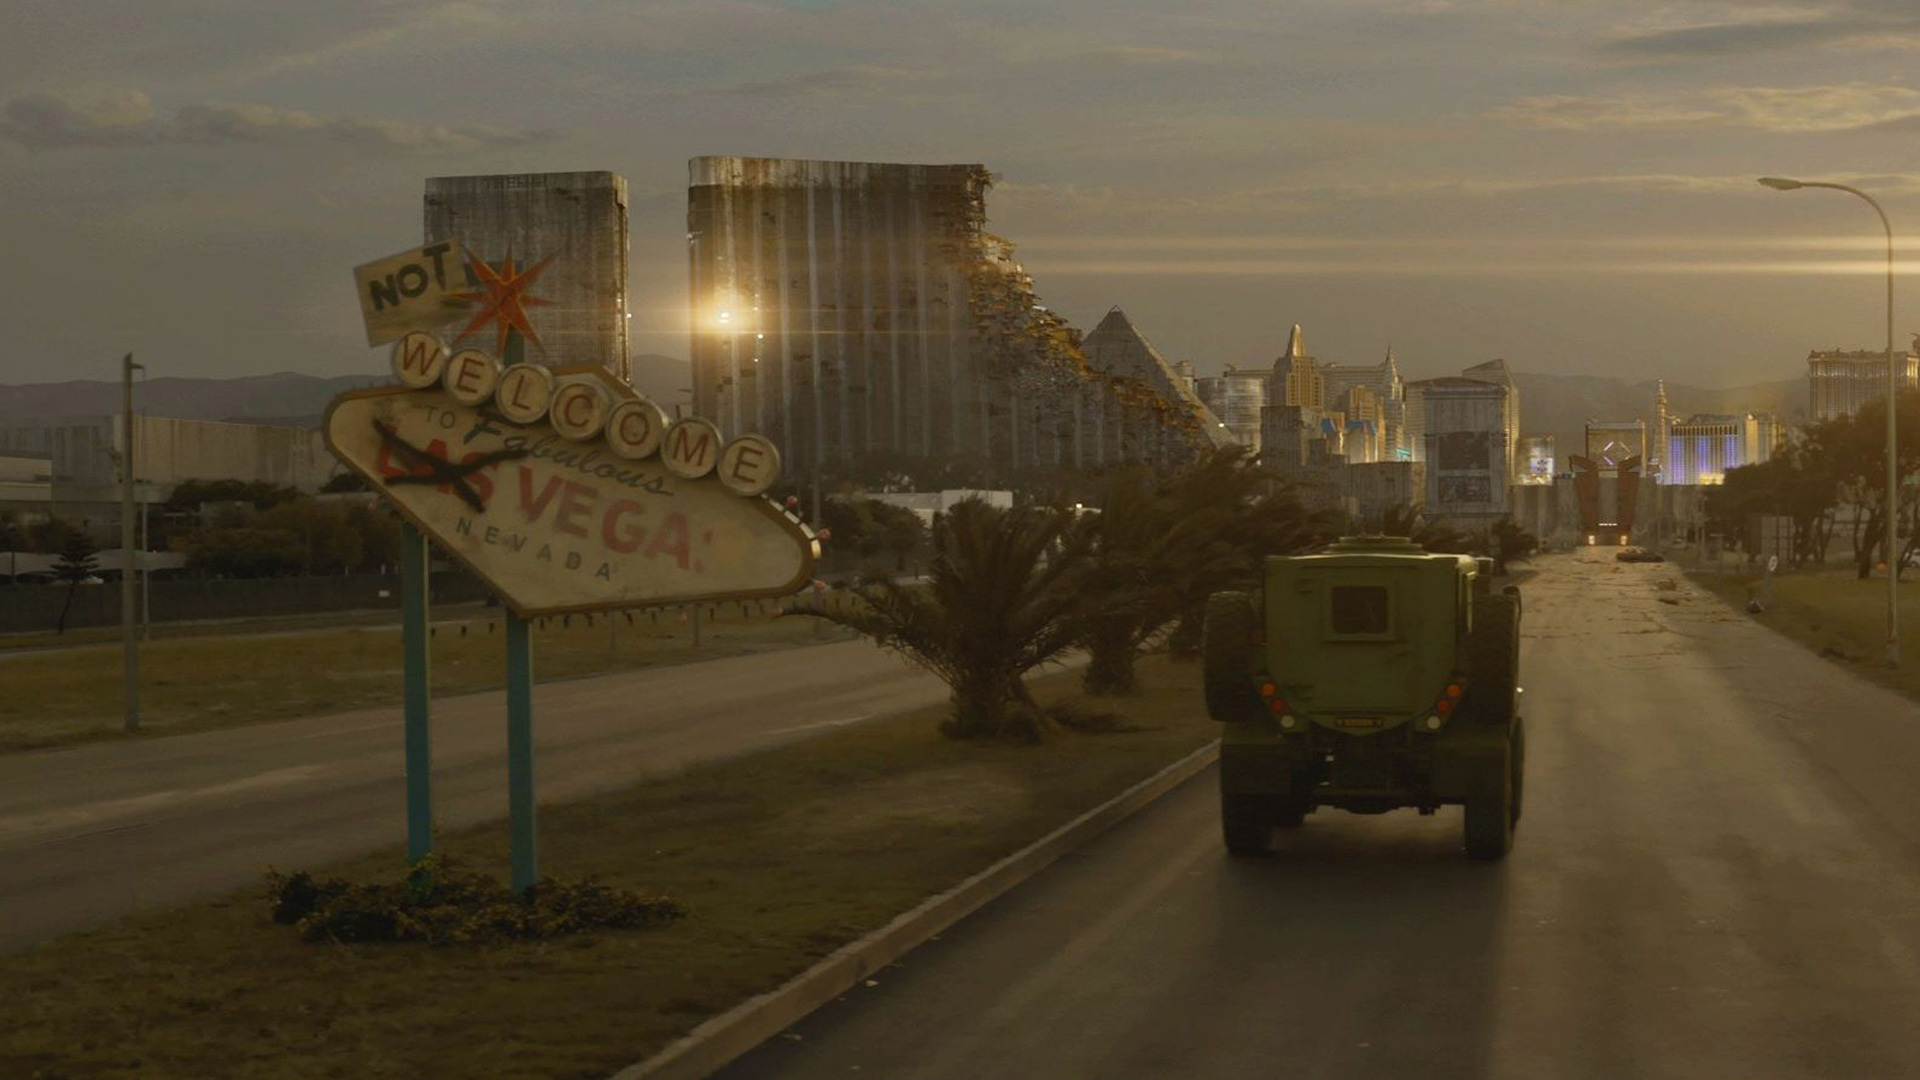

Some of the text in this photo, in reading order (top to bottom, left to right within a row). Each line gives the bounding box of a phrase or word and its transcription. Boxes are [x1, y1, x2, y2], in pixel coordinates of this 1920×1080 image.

[368, 243, 451, 311] NOT
[402, 337, 763, 484] WELCOME
[426, 405, 675, 498] TO Fabulous
[457, 517, 611, 581] NEVADA
[518, 464, 714, 574] VEGA
